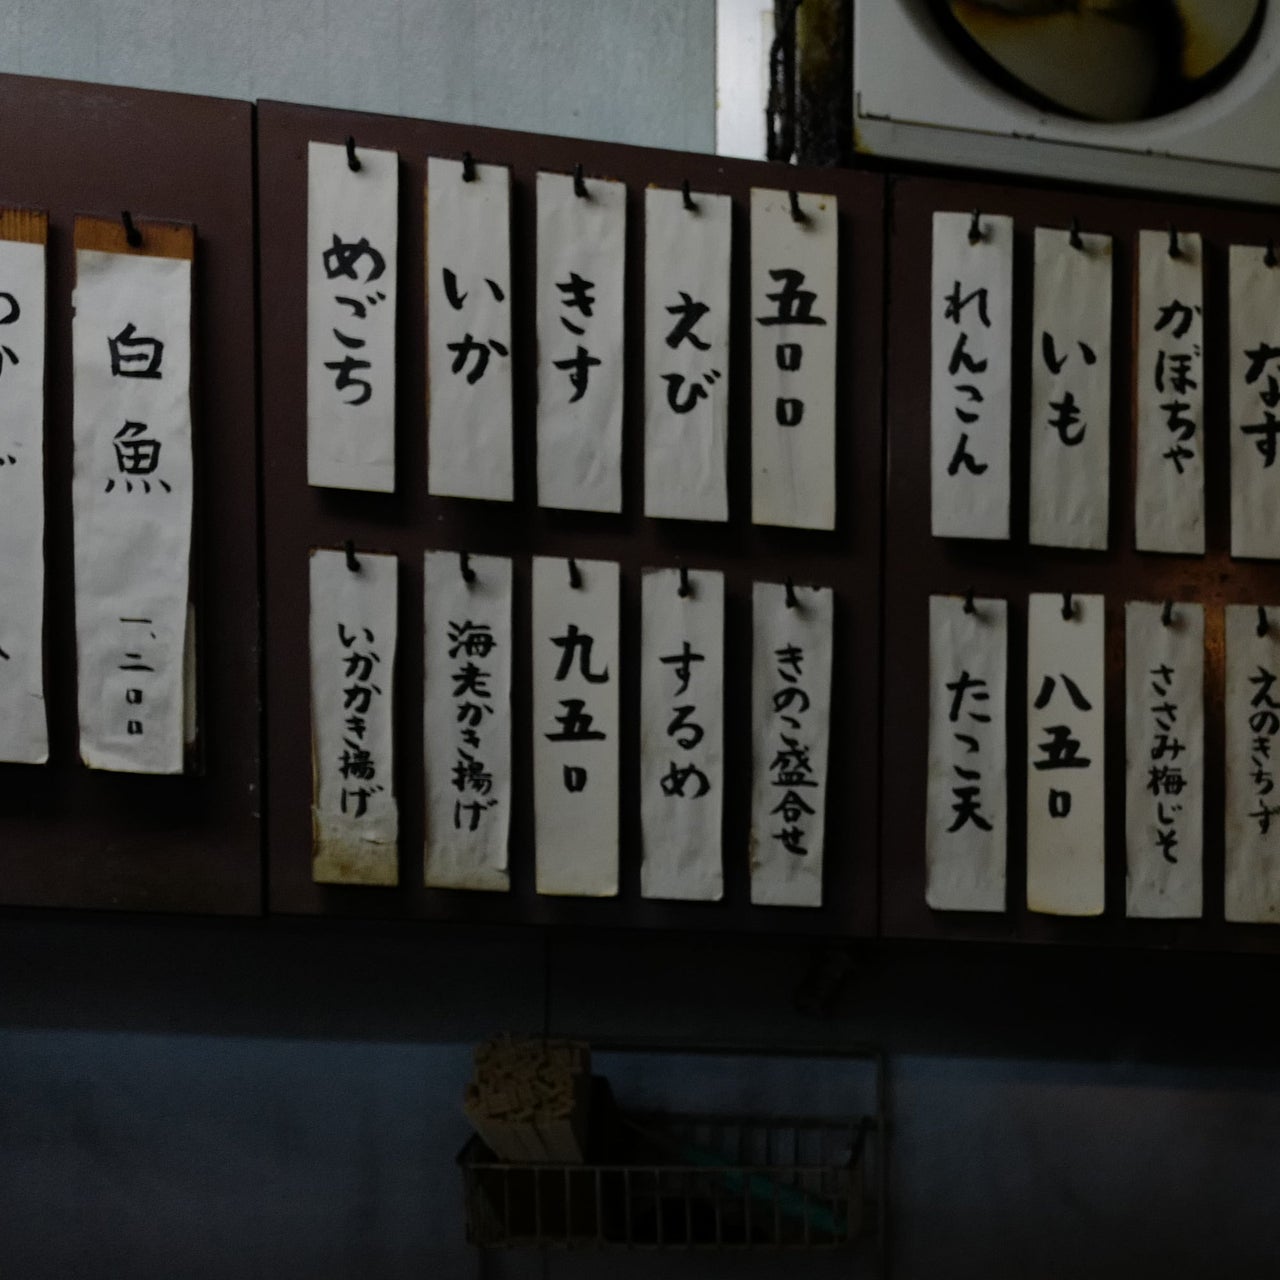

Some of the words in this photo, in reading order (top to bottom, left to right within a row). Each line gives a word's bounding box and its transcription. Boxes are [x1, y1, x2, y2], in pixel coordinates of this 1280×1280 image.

[322, 233, 387, 407] めごち
[442, 267, 509, 386] いか
[552, 272, 602, 404] きす
[660, 291, 722, 415] えび
[944, 280, 992, 477] れんこん
[1041, 331, 1097, 447] いも
[1153, 299, 1202, 475] かぼちゃ
[104, 322, 172, 494] 白魚
[337, 623, 384, 819] いかかき揚げ
[447, 620, 499, 832] 海老かき揚げ
[659, 641, 711, 799] するめ
[769, 643, 819, 857] きのこ盛合せ
[945, 670, 994, 834] たこ天
[1146, 664, 1188, 865] ささみ梅じそ
